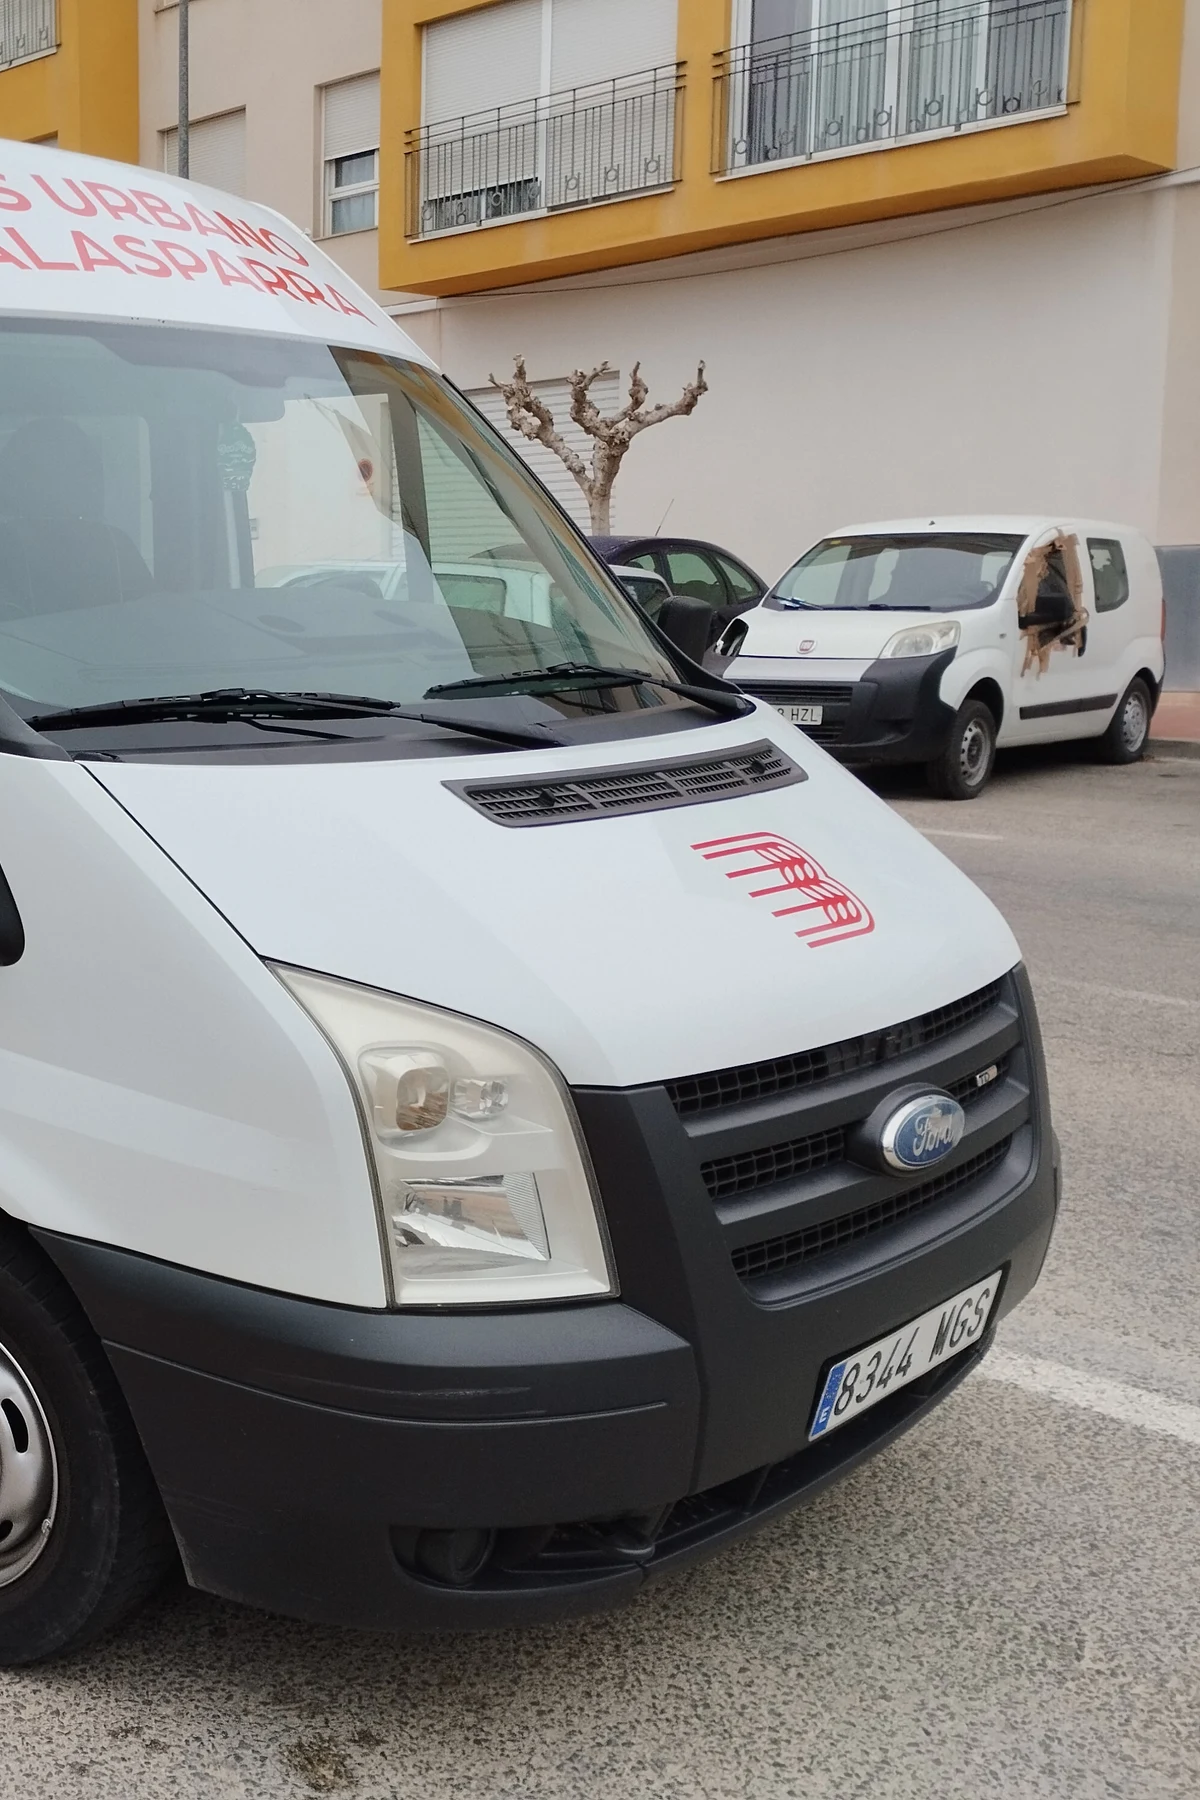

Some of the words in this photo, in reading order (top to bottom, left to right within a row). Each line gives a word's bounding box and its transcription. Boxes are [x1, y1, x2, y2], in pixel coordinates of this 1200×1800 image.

[30, 173, 310, 268] URBANO
[790, 707, 818, 722] HZL
[912, 1112, 954, 1157] Ford
[833, 1326, 920, 1416] 8344
[928, 1287, 990, 1363] MGS
